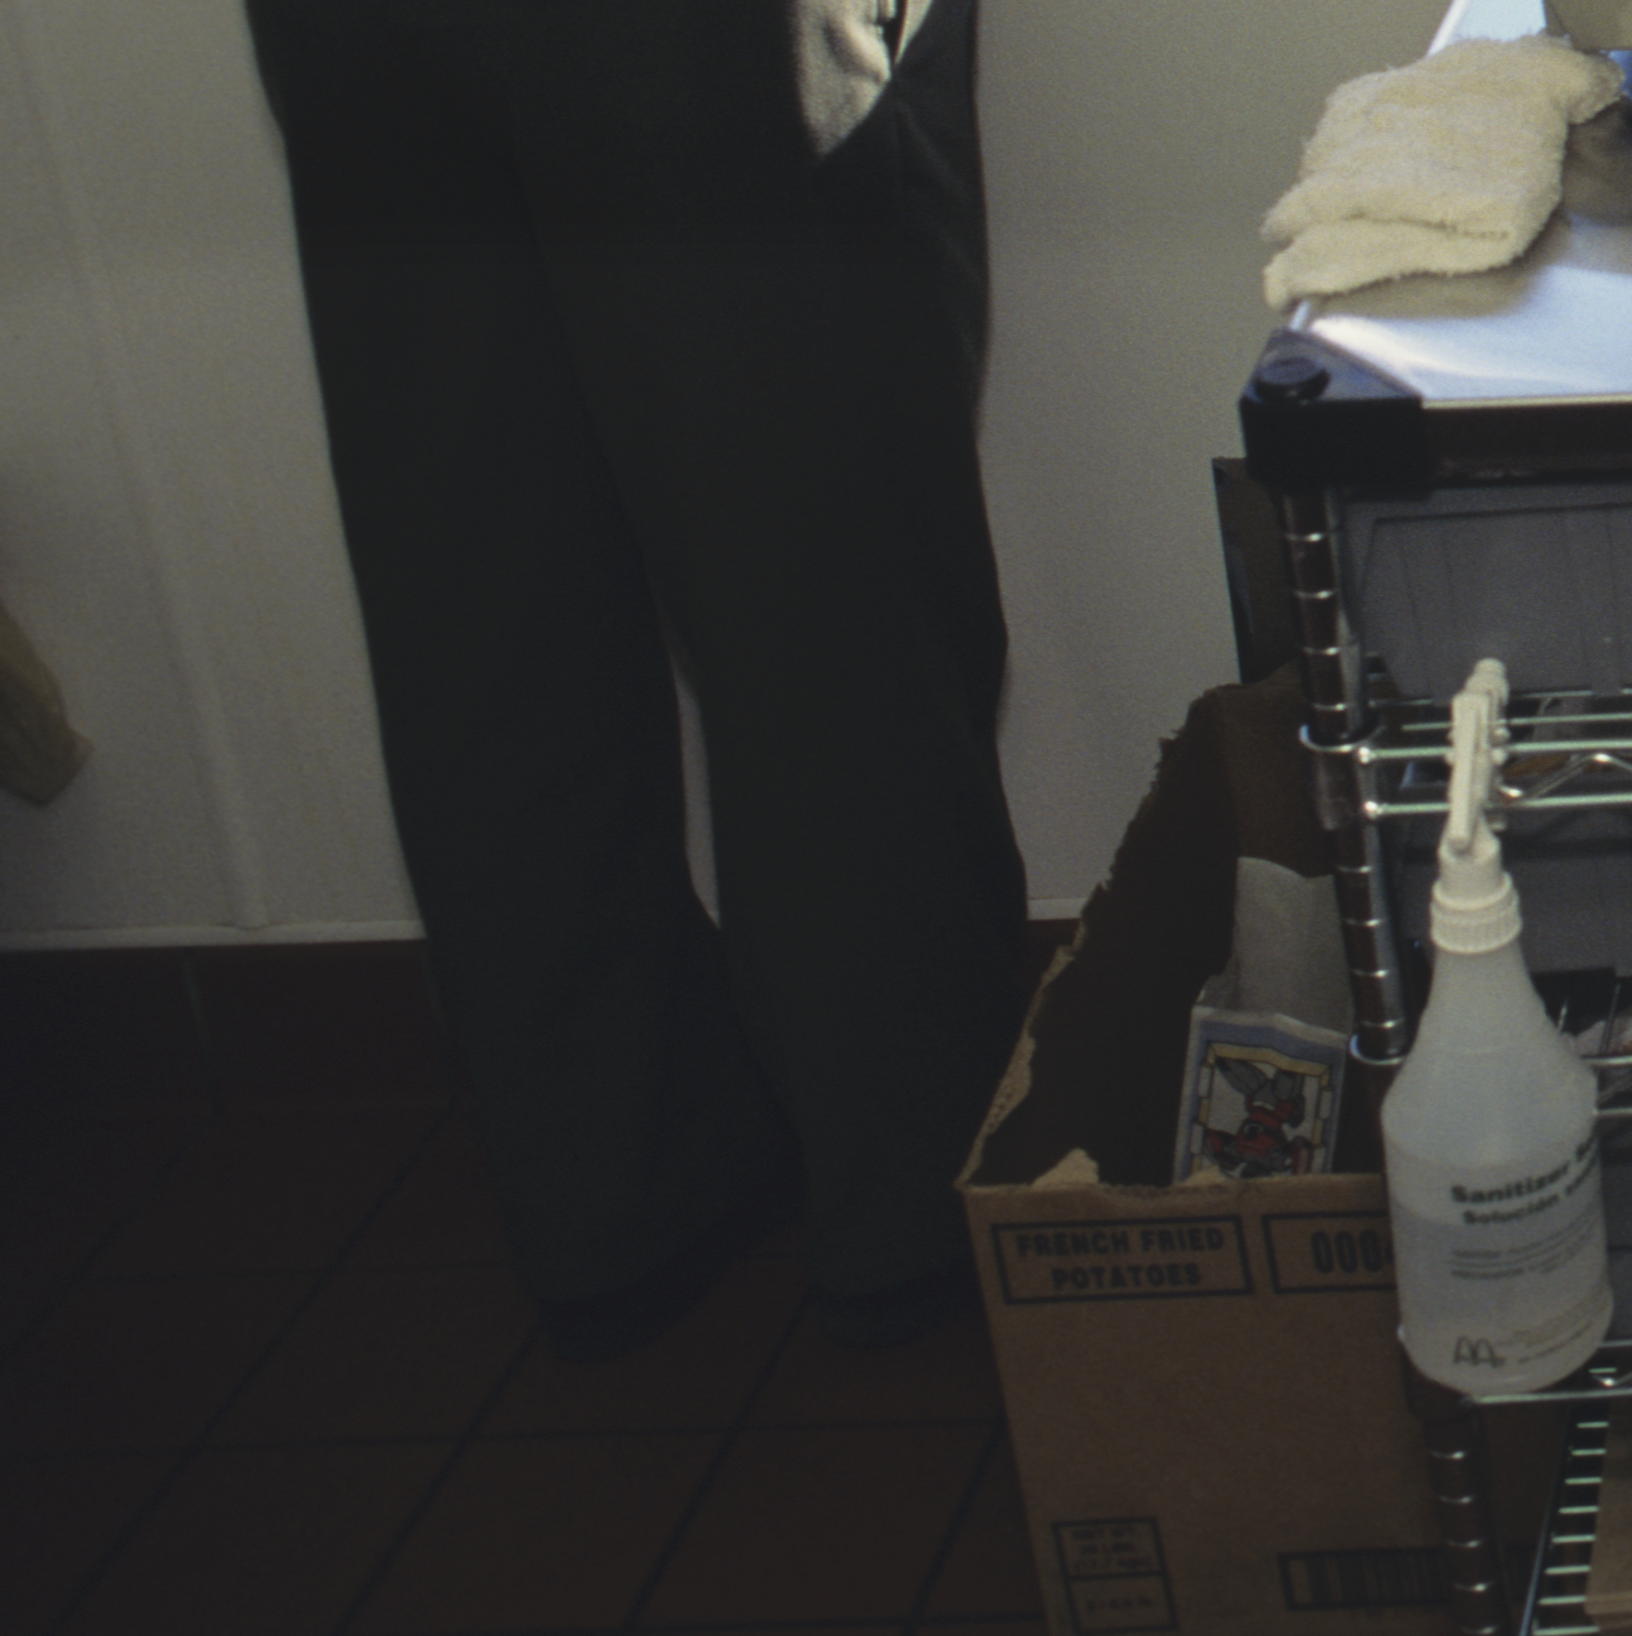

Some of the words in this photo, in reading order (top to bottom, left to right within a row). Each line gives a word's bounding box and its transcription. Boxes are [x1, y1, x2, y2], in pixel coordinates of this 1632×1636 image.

[1452, 1160, 1571, 1203] Sanitizer
[1016, 1231, 1130, 1258] FRENCH
[1141, 1228, 1225, 1253] FRIED
[1311, 1230, 1394, 1273] 000
[1052, 1263, 1201, 1290] POTATOES
